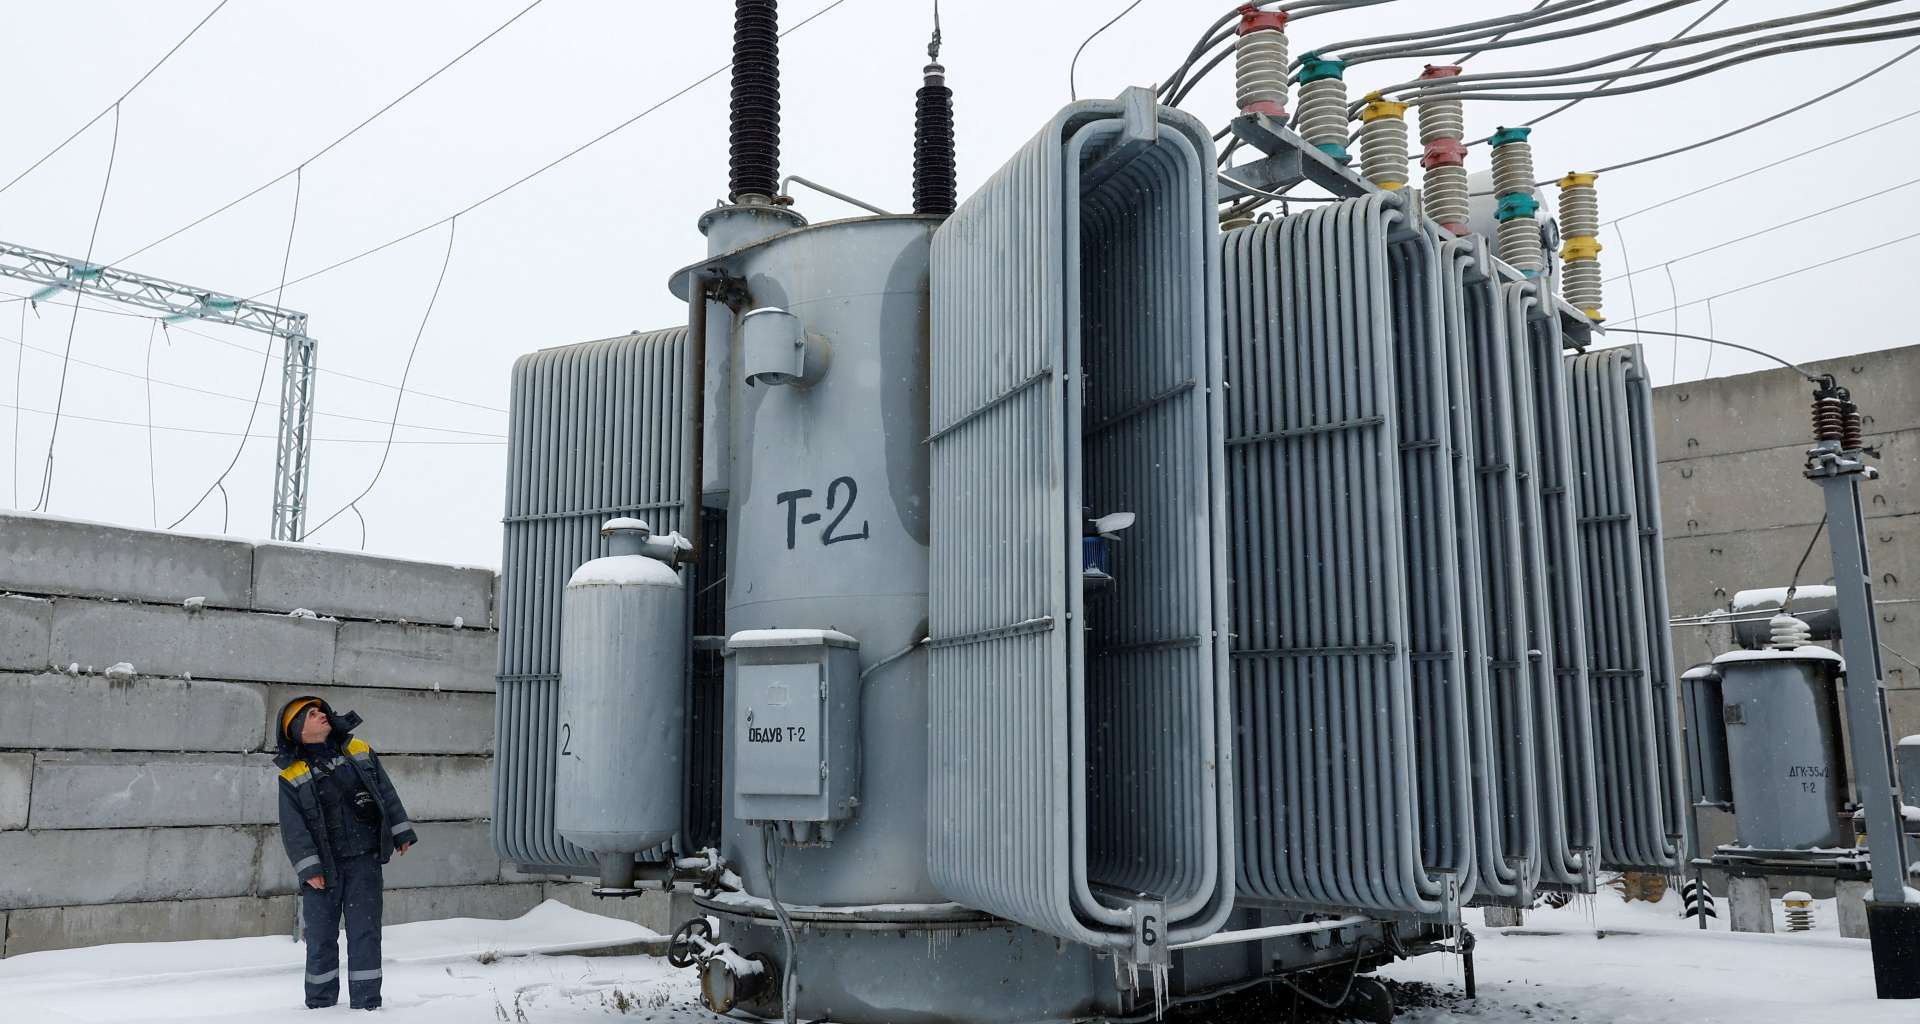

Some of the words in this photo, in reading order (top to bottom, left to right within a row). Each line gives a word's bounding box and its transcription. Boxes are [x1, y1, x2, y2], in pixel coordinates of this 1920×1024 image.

[777, 476, 869, 549] Т-2
[562, 723, 571, 755] 2
[749, 728, 782, 743] ОБДУВ
[787, 727, 805, 742] Т-2
[1450, 881, 1455, 901] 5
[1142, 915, 1157, 946] 6
